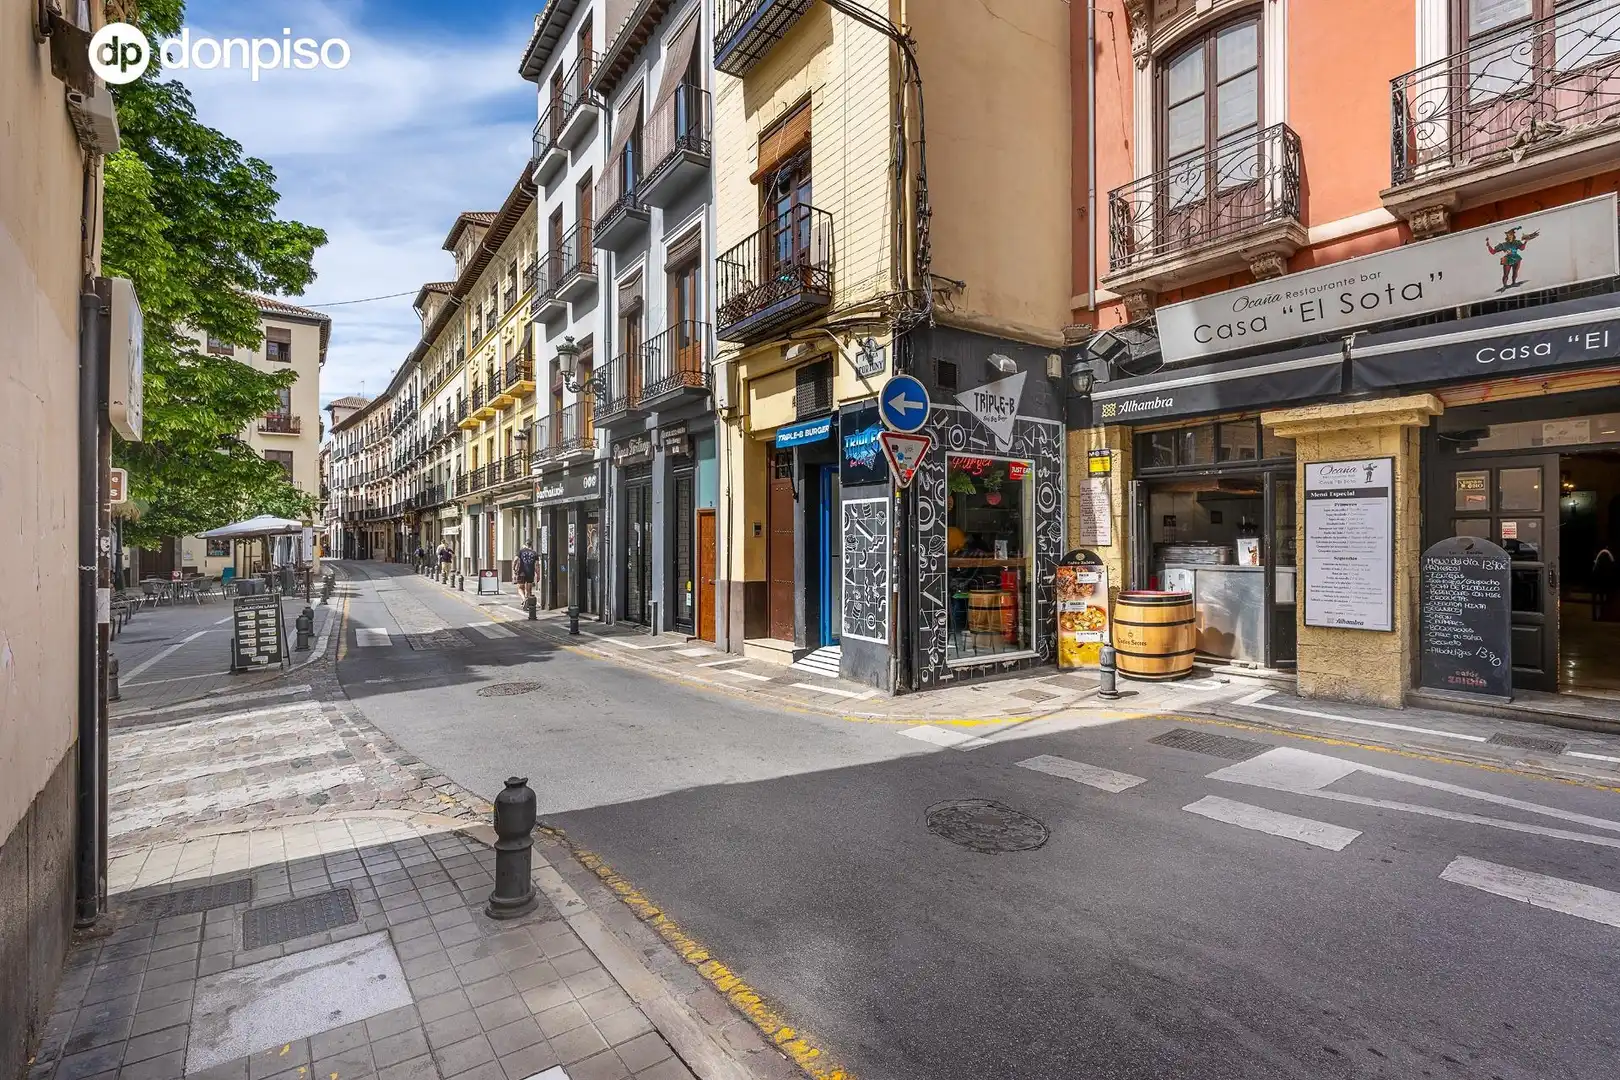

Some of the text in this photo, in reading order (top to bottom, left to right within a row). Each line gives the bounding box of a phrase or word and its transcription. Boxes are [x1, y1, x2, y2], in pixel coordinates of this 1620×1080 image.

[1232, 271, 1382, 313] Ocaña Restaurante bar
[1194, 316, 1268, 344] Casa
[1476, 342, 1551, 364] Casa
[974, 390, 1015, 416] TRIPLE-B
[1118, 396, 1174, 416] Alhambra
[778, 425, 830, 442] TRIPLE-B BURGER
[1011, 466, 1022, 474] JUST
[1336, 617, 1365, 626] Alhambra
